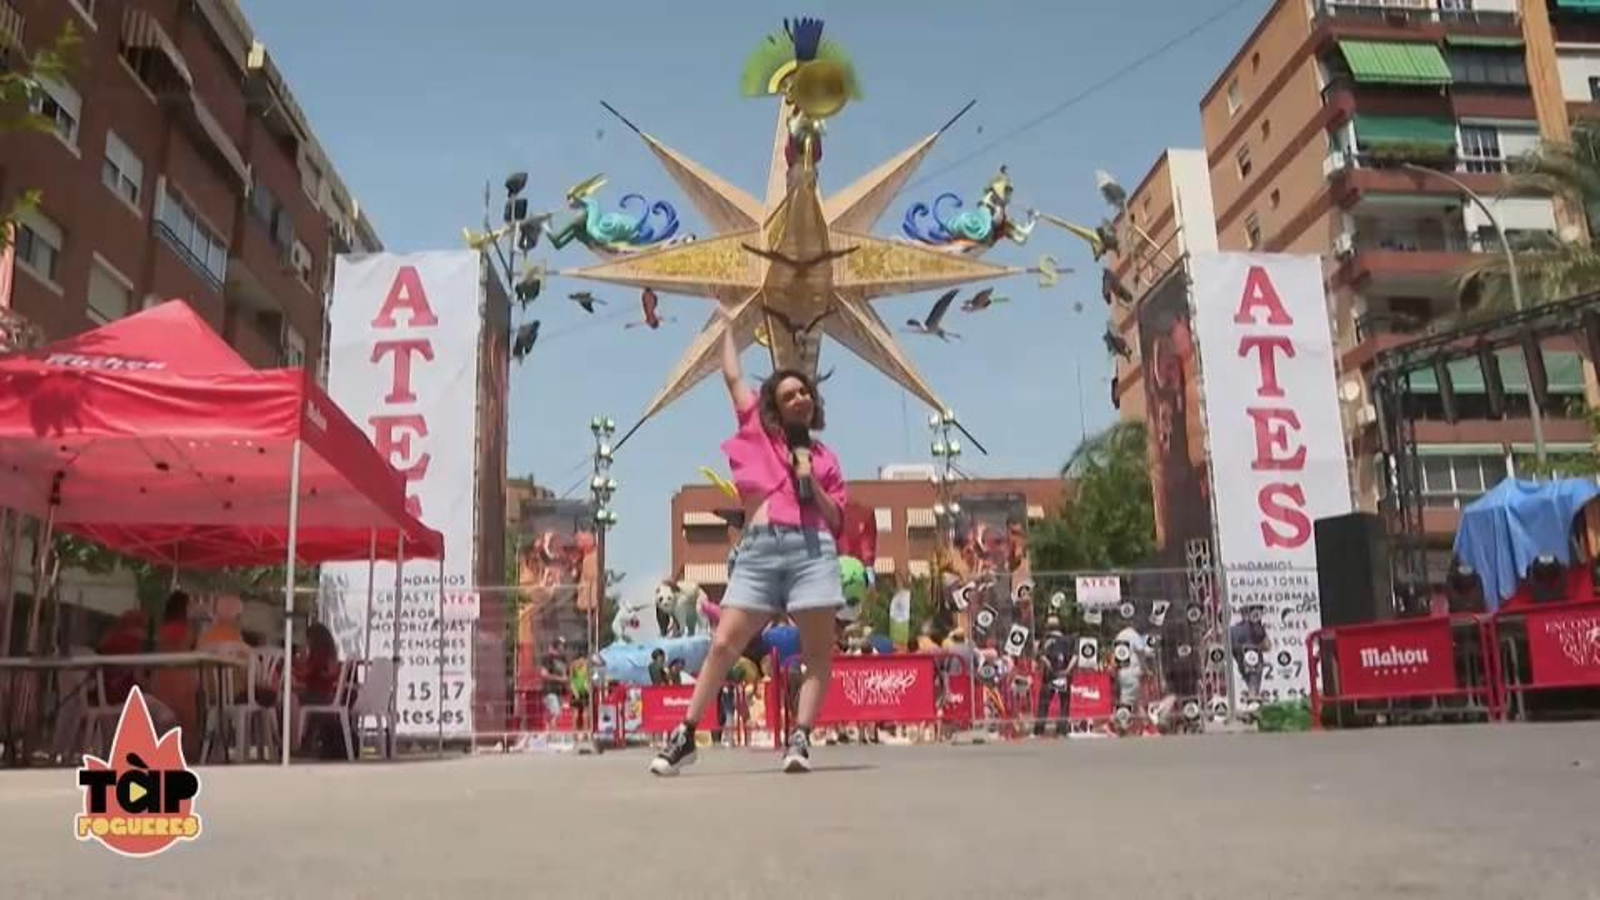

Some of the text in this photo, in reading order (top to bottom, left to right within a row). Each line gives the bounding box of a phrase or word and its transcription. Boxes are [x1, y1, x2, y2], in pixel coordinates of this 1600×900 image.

[369, 266, 438, 518] ATE
[1234, 266, 1312, 548] ATES
[1360, 645, 1429, 668] Mahou
